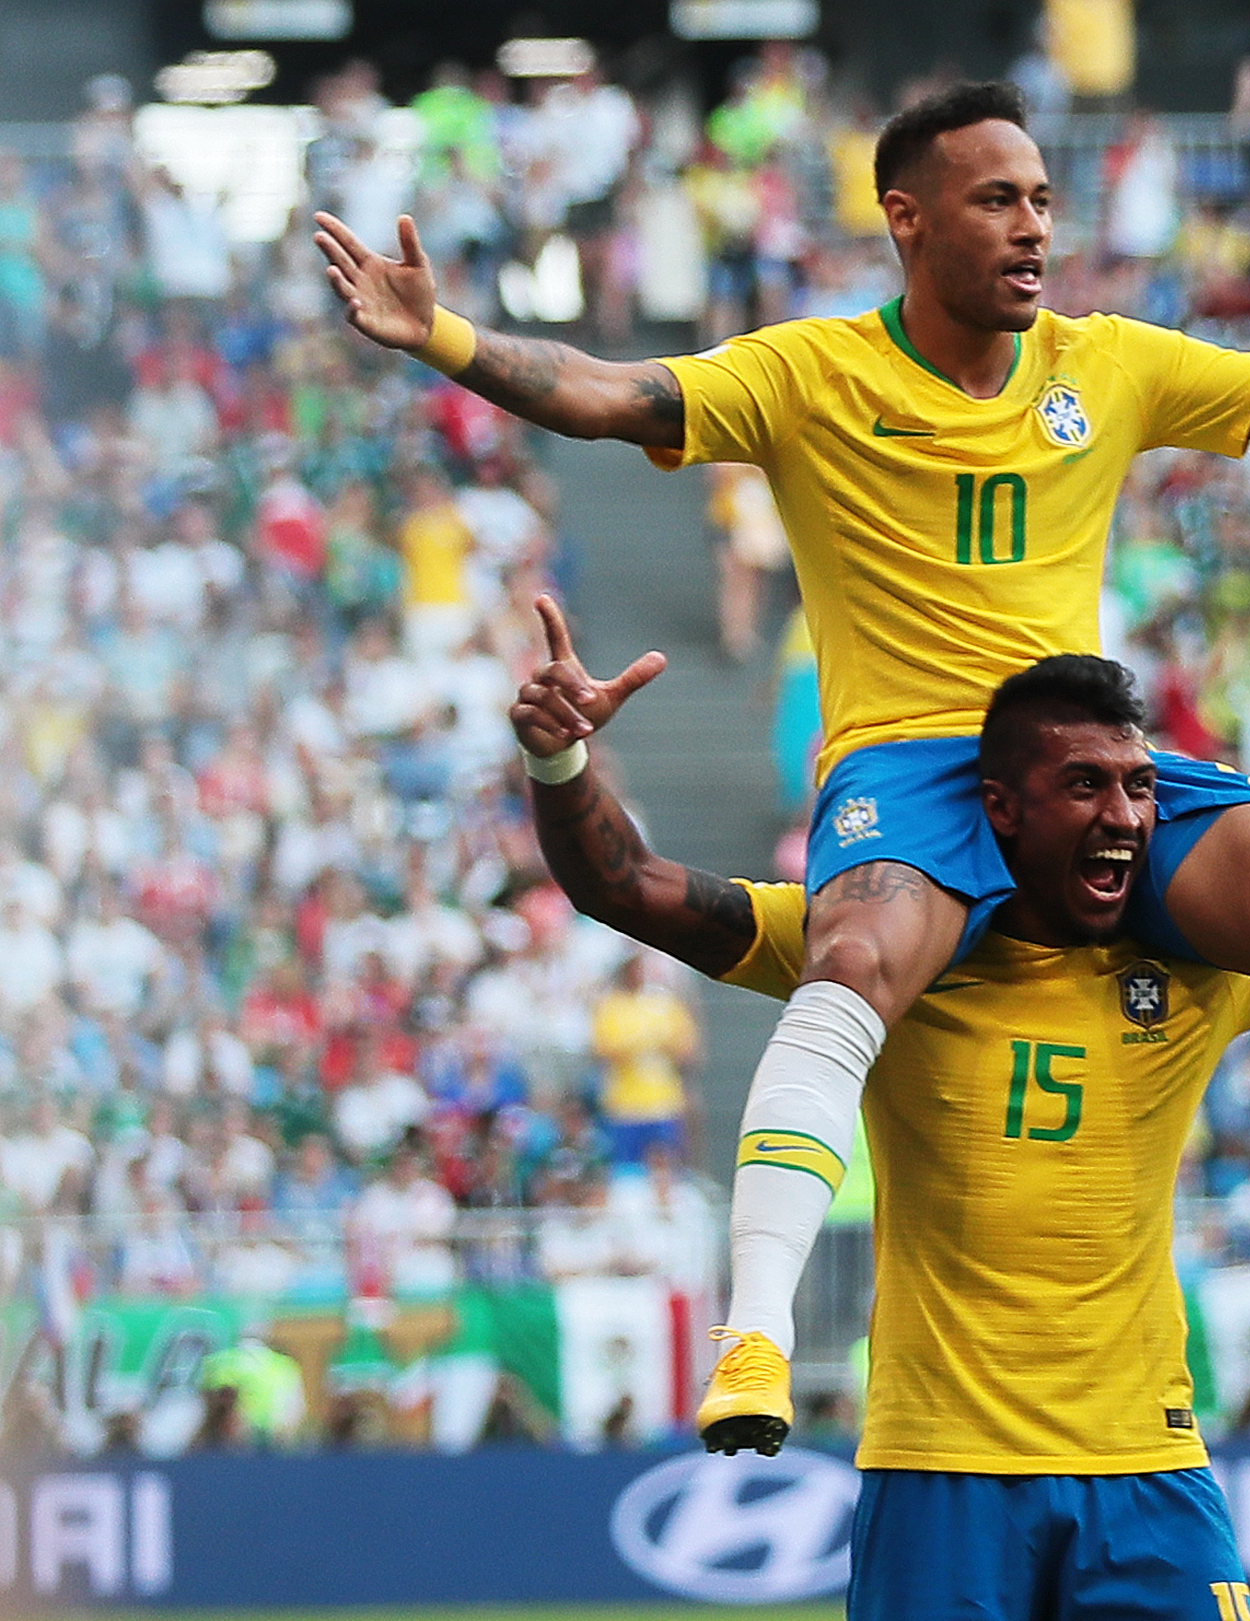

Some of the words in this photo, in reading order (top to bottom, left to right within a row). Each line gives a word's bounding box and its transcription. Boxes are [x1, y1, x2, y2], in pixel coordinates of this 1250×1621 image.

[955, 472, 1027, 565] 10
[1003, 1040, 1086, 1142] 15
[0, 1472, 174, 1597] AI
